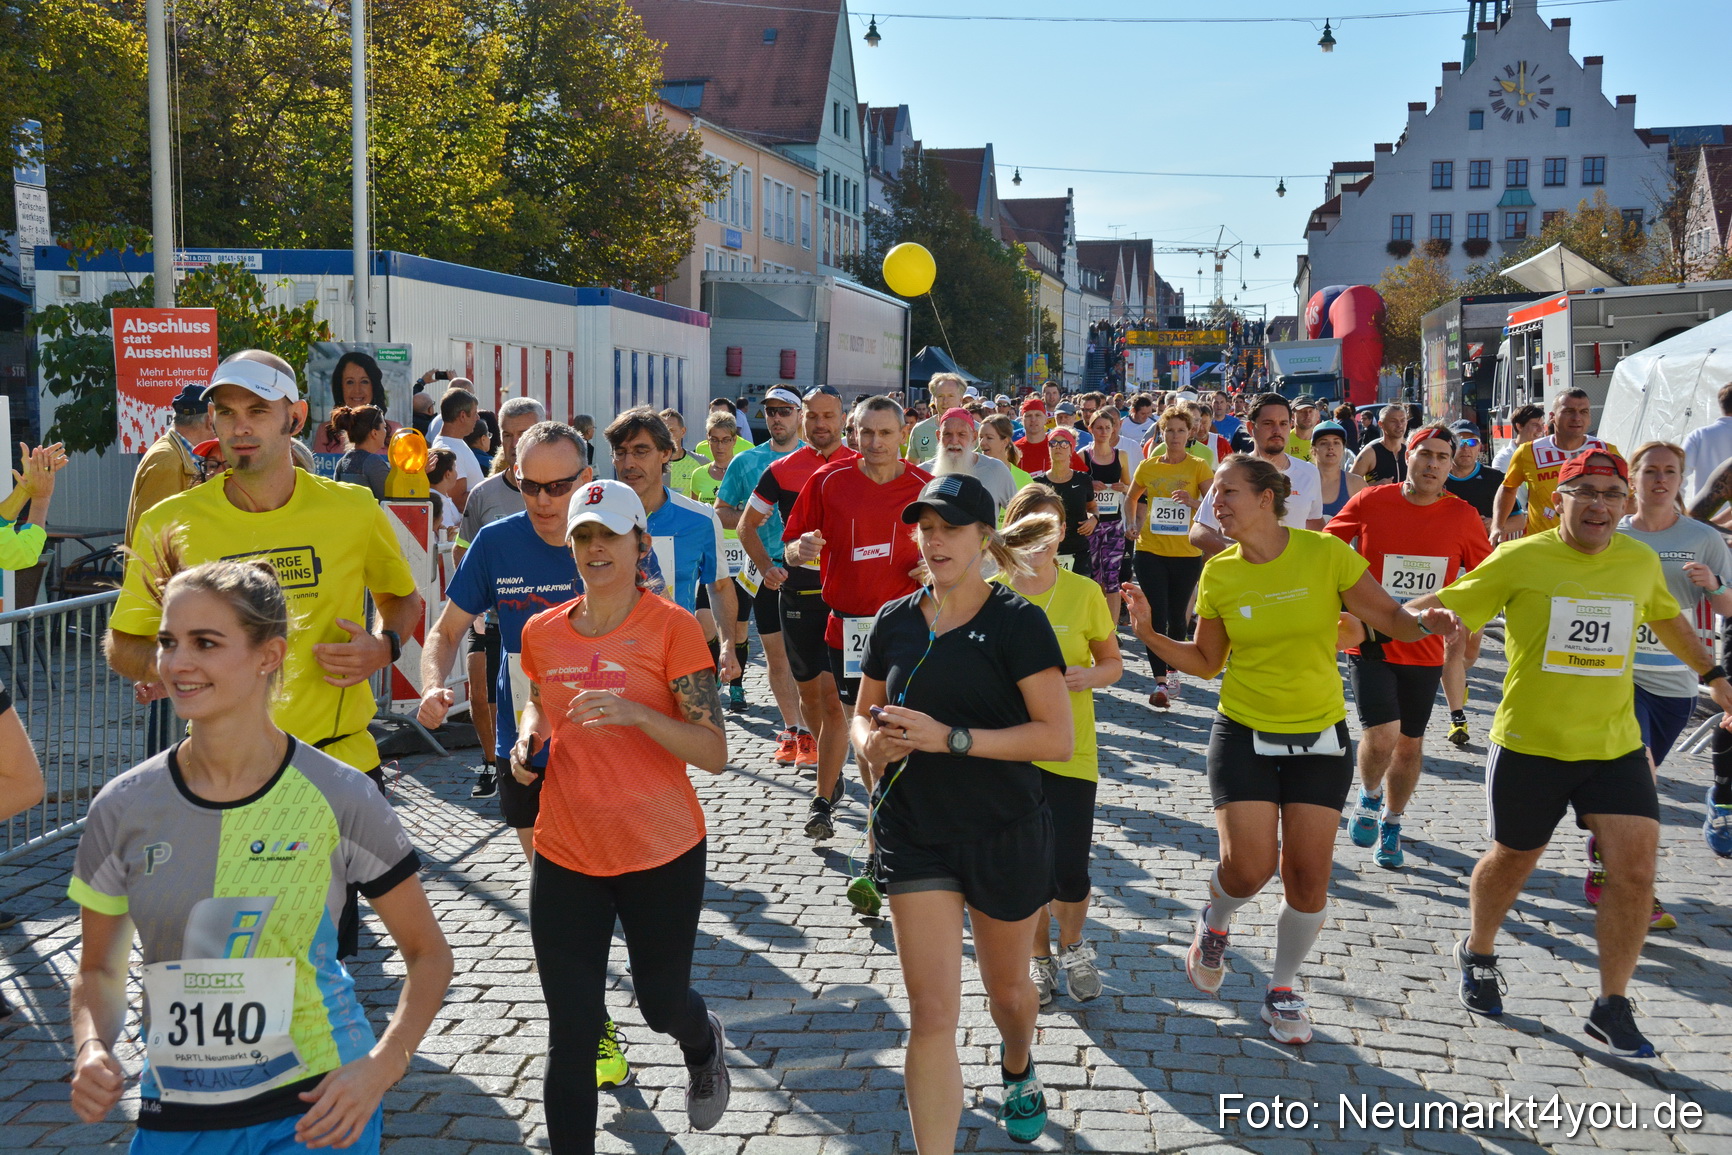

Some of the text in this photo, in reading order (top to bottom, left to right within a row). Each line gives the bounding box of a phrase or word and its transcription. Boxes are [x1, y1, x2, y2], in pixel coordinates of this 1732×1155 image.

[22, 192, 42, 202] nur mit
[18, 200, 46, 213] Parkschein
[21, 212, 45, 224] werktags
[122, 318, 211, 334] Abschluss
[122, 334, 152, 344] statt
[1158, 332, 1194, 343] START
[124, 345, 212, 359] Ausschluss!
[140, 367, 209, 377] Mehr Lehrer für
[136, 378, 210, 388] kleinere Klassen.
[585, 485, 605, 506] B
[1156, 507, 1185, 520] 2516
[269, 556, 302, 569] ARGE
[1403, 560, 1430, 568] BOCK
[279, 568, 311, 581] HINS
[1392, 571, 1436, 590] 2310
[496, 577, 524, 585] MAINOVA
[496, 583, 572, 594] FRANKFURT MARATHON
[1576, 605, 1611, 615] BOCK
[1568, 620, 1611, 643] 291
[1567, 654, 1606, 667] Thomas
[558, 666, 588, 674] balance
[545, 671, 626, 683] FALMOUTH
[183, 972, 245, 989] BOCK
[168, 1001, 266, 1046] 3140
[175, 1052, 248, 1061] PARTL Neumarkt
